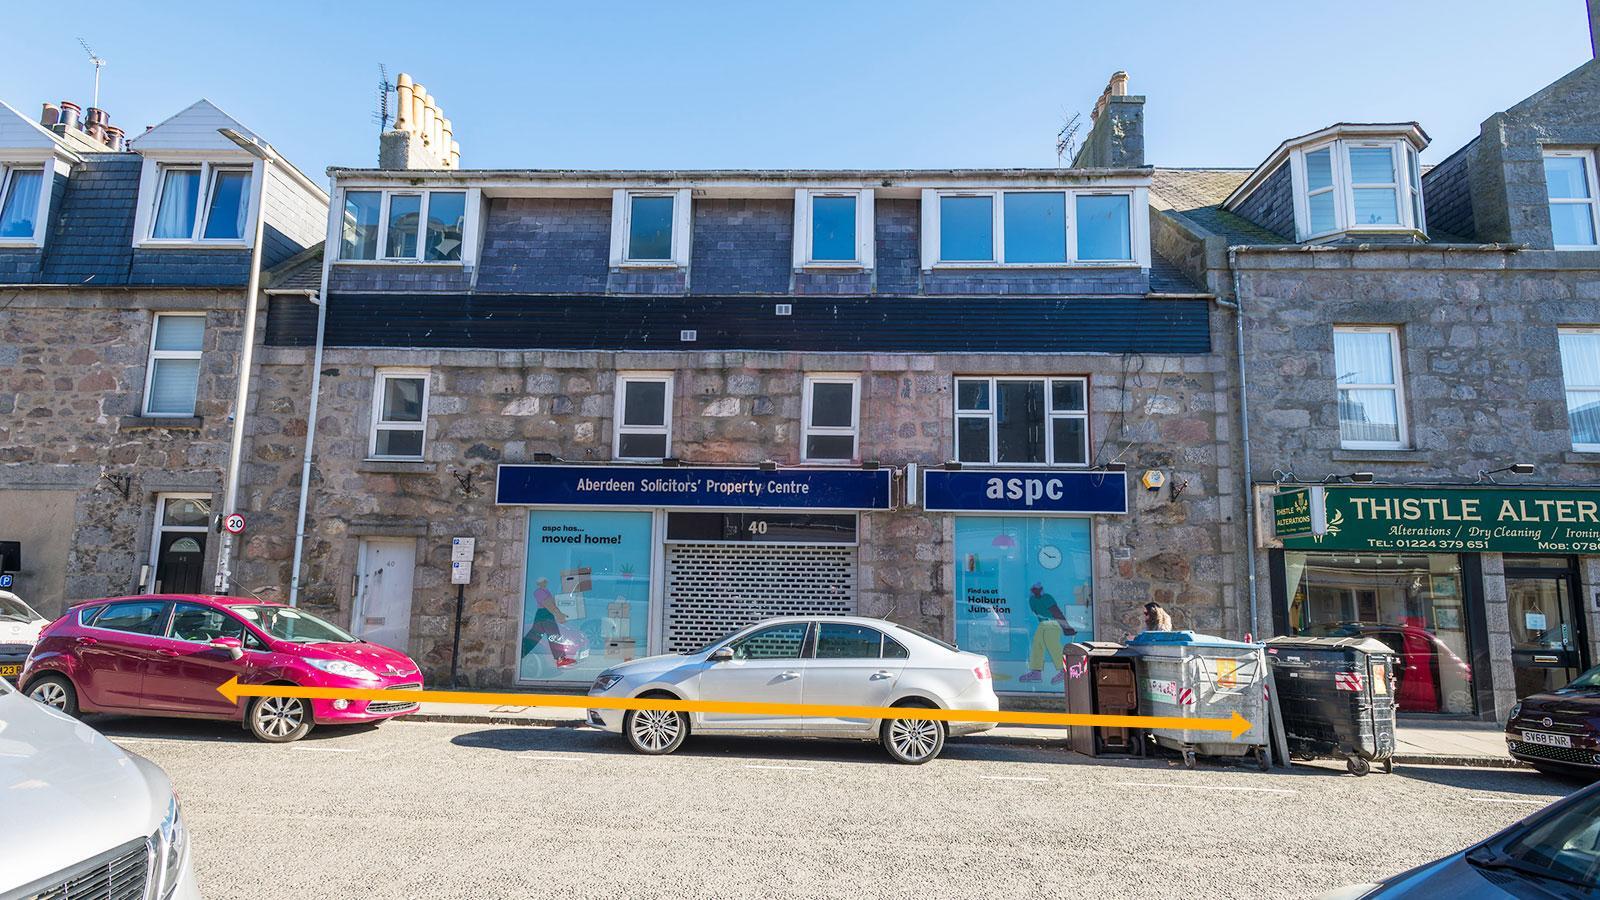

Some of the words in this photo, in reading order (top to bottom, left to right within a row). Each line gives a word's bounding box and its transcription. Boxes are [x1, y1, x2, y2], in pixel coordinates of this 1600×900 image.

[577, 478, 635, 492] Aberdeen
[640, 479, 701, 493] Solicitors'
[706, 480, 762, 496] Property
[767, 480, 810, 494] Centre
[986, 477, 1064, 506] aspc
[1349, 497, 1482, 521] THISTLE
[1497, 499, 1600, 522] ALTER
[229, 519, 243, 528] 20
[1277, 516, 1311, 526] ALTERATIONS
[542, 525, 561, 533] aspc
[748, 521, 767, 534] 40
[1388, 524, 1452, 536] Alterations
[1468, 526, 1491, 539] Dry
[1493, 526, 1542, 540] Cleaning
[542, 534, 582, 543] moved
[584, 535, 622, 544] home!
[1367, 539, 1394, 547] TEL:
[1396, 540, 1437, 548] 01224
[1439, 540, 1464, 548] 379
[968, 605, 1011, 614] Junction
[1525, 732, 1547, 743] SV68
[1549, 735, 1567, 746] FNR
